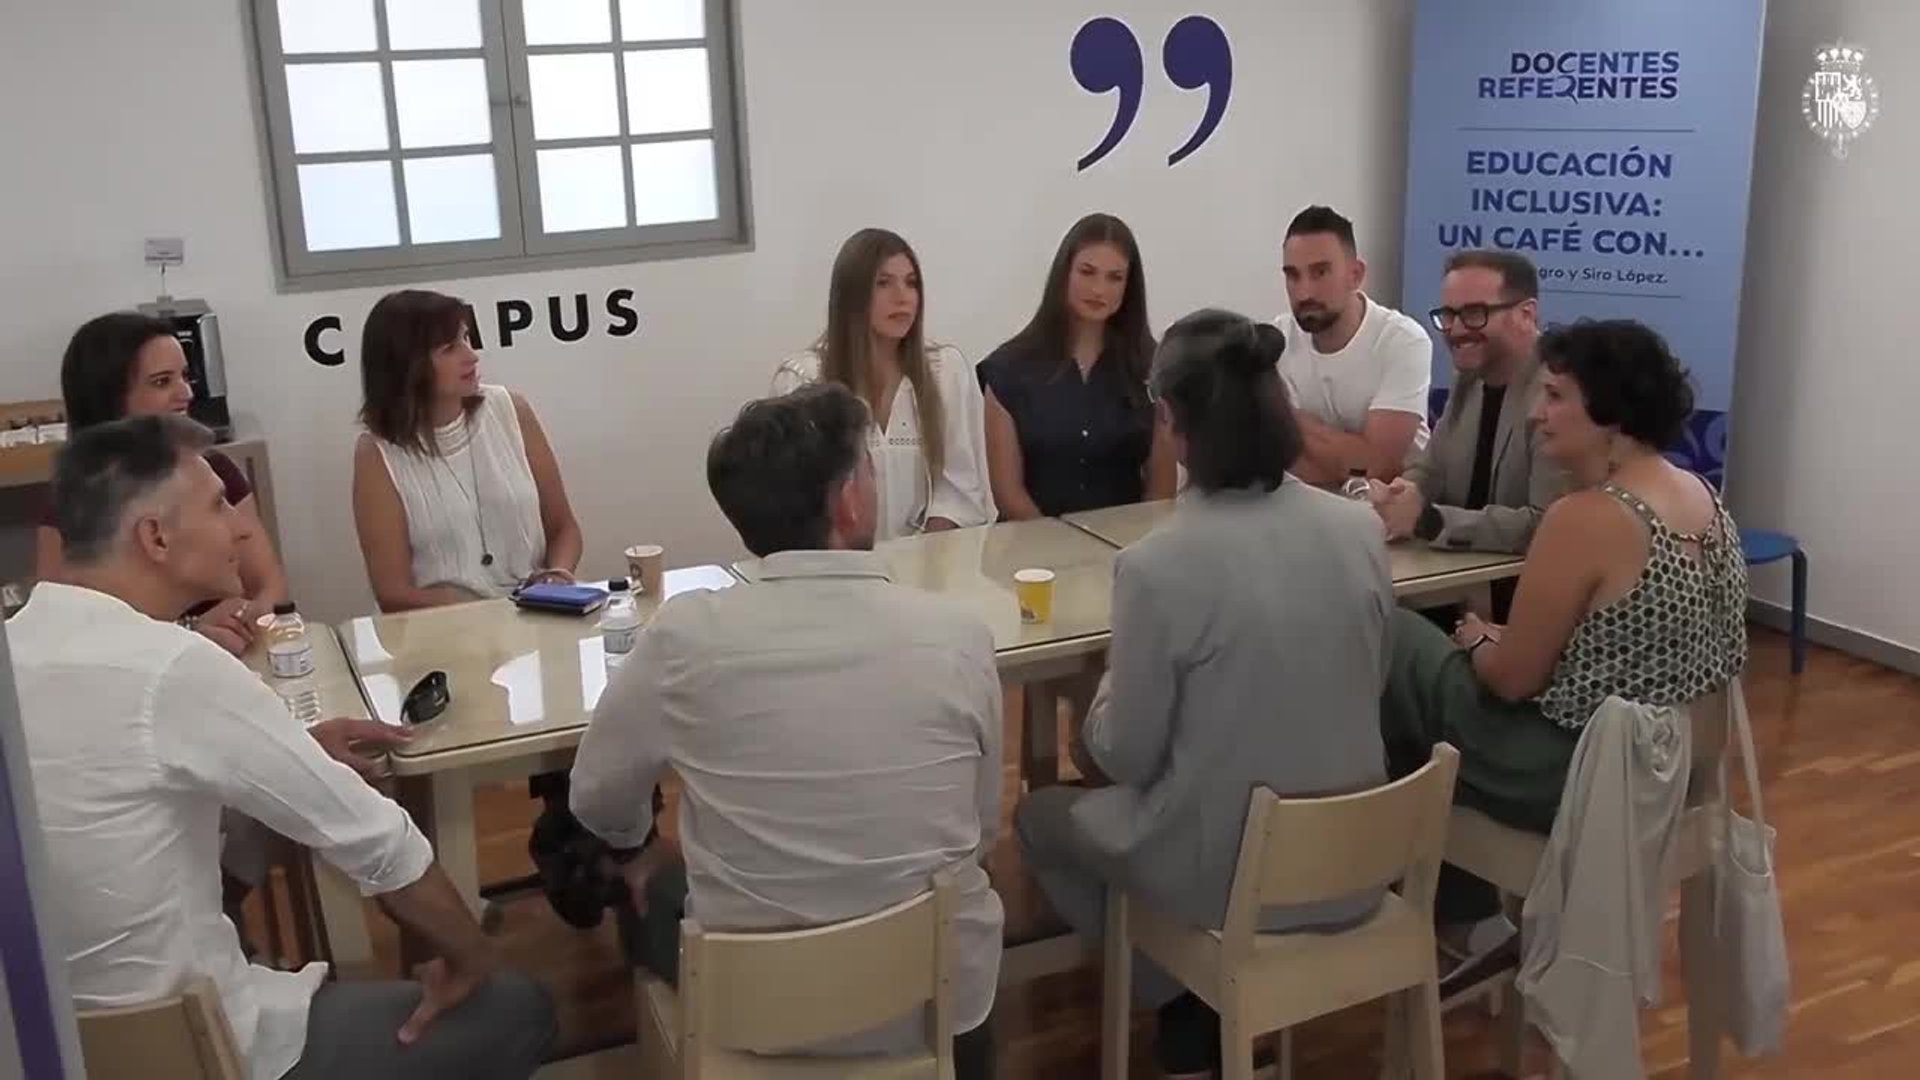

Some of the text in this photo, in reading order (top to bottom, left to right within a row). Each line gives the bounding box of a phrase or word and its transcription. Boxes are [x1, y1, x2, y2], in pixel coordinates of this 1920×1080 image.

[1511, 51, 1680, 75] DOCENTES
[1478, 75, 1678, 104] REFERENTES
[1466, 146, 1672, 178] EDUCACIÓN
[1471, 189, 1661, 217] INCLUSIVA:
[1439, 222, 1704, 257] UN CAFÉ CON...
[1568, 270, 1578, 281] y
[1583, 267, 1612, 281] Siro
[1617, 269, 1668, 285] López.
[304, 289, 638, 366] CPUS
